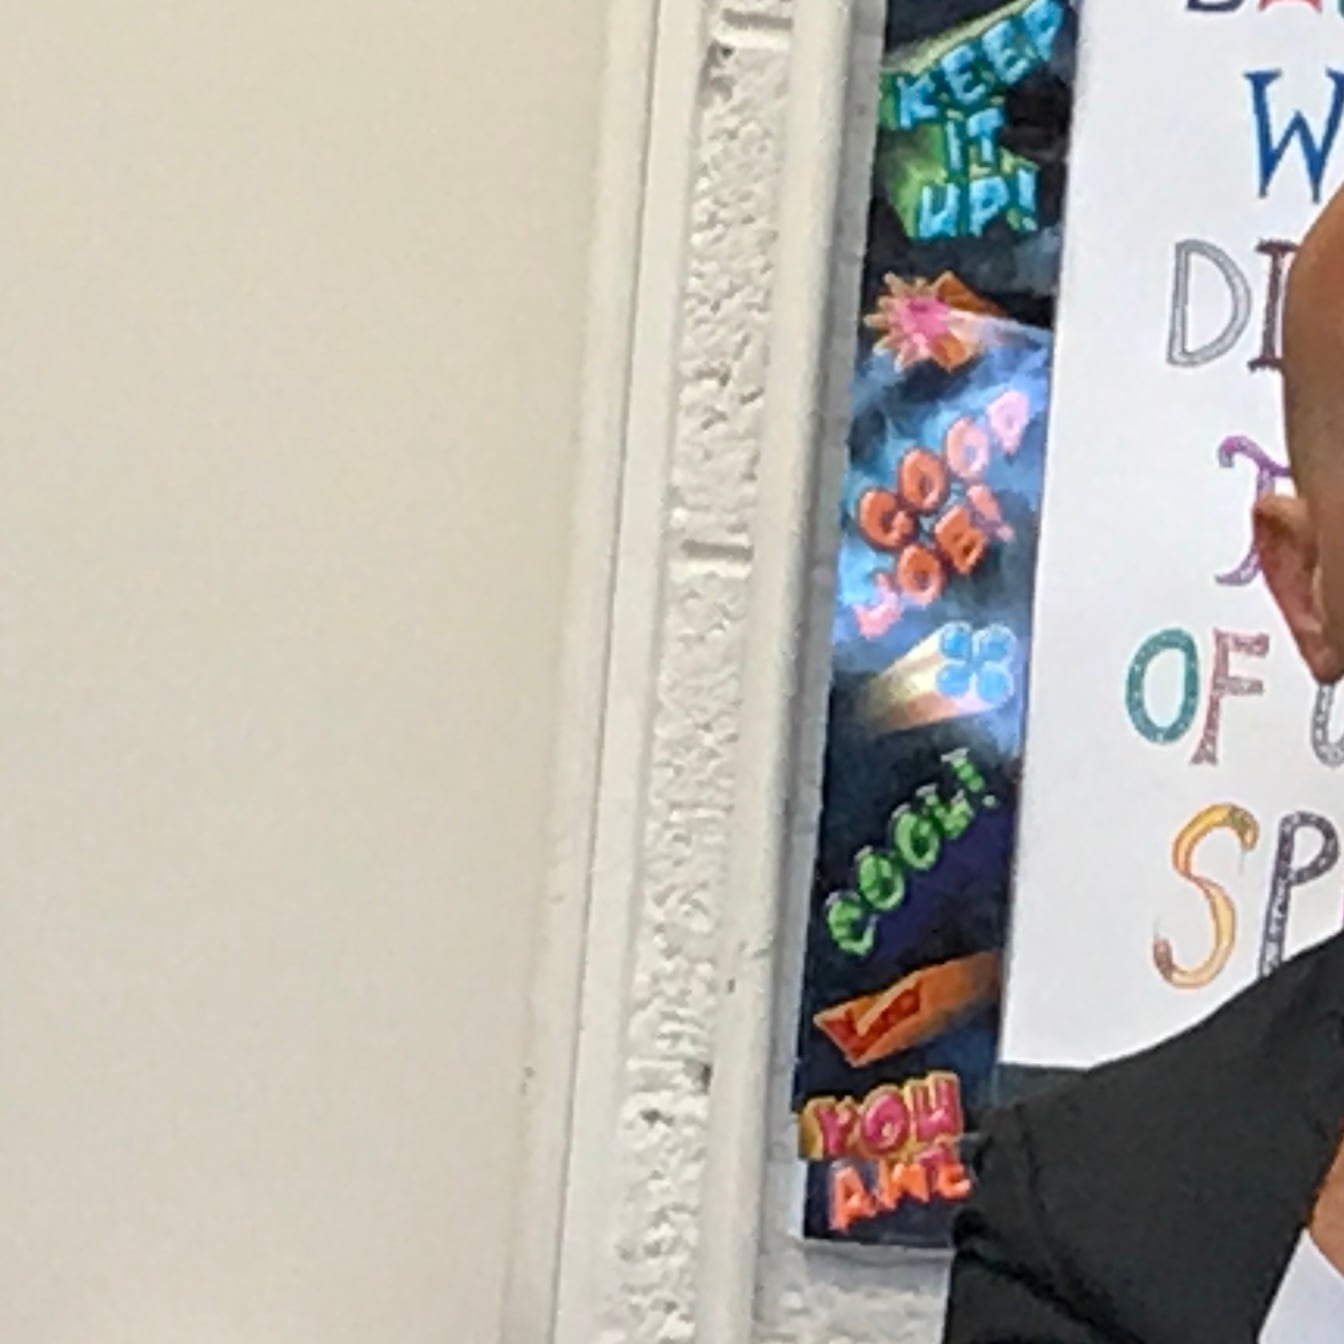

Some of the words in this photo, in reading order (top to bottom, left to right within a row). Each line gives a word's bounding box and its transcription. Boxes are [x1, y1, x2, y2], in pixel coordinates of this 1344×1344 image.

[895, 0, 1063, 130] KEEP
[917, 168, 1039, 239] UP!
[944, 106, 1005, 172] IT
[856, 389, 1030, 552] GOOD
[852, 484, 1017, 640] JOB!
[1125, 627, 1271, 768] OF
[825, 747, 997, 957] COOL!
[805, 1072, 963, 1159] YOU
